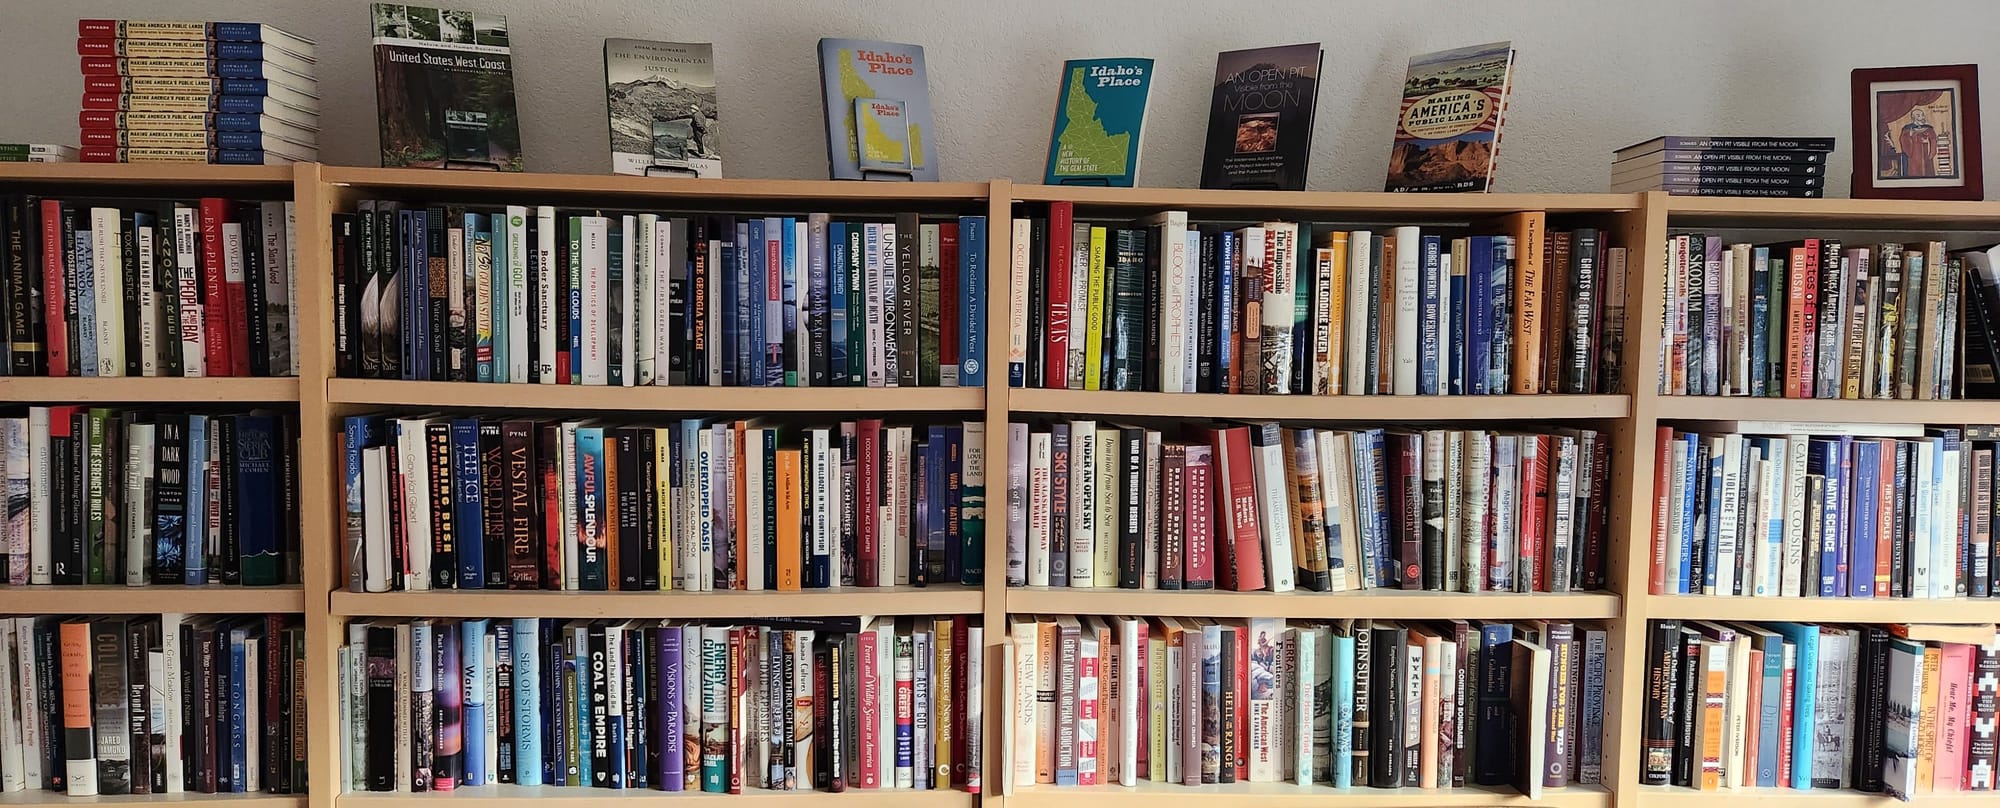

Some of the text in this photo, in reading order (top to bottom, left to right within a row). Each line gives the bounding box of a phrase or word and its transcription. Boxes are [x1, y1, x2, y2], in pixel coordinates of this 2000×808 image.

[389, 50, 506, 71] United States West Coast
[633, 54, 707, 64] ENVIRONMENTAL
[857, 50, 913, 64] Idaho's
[868, 63, 914, 76] Place
[1090, 65, 1144, 77] Idaho's
[1224, 66, 1307, 85] AN OPEN PIT
[1097, 77, 1141, 88] Place
[1223, 89, 1301, 112] MOON
[1427, 93, 1471, 104] MAKING
[871, 103, 899, 111] Idaho's
[1408, 112, 1483, 127] PUBLIC LANDS
[1410, 99, 1485, 119] AMERICA'S
[1059, 164, 1070, 172] THE
[1082, 164, 1098, 172] STATE
[1060, 157, 1081, 165] HISTORY
[204, 217, 215, 242] END
[67, 249, 77, 287] YOSEMITE
[206, 252, 218, 298] PLENTY
[229, 234, 239, 274] BOWLER
[969, 252, 977, 262] To
[1093, 246, 1101, 274] SHAPING
[1263, 229, 1275, 294] RAILWAY
[1274, 230, 1286, 295] The Impossible
[1792, 254, 1804, 299] BULOSAN
[11, 229, 25, 336] THE ANIMAL GAME
[68, 289, 77, 315] MAFIA
[161, 226, 176, 335] TANOAK TREE
[540, 250, 549, 331] Border Sanctuary
[571, 239, 580, 320] TO THE WHITE CLOUDS
[695, 255, 704, 350] THE GEORGIA PEACH
[902, 244, 912, 336] YELLOW RIVER
[969, 264, 977, 294] Reclaim
[1092, 289, 1100, 311] PUBLIC
[1523, 269, 1535, 335] THE FAR WEST
[1688, 254, 1703, 312] SKOOKUM
[1049, 302, 1068, 344] TEXAS
[1317, 261, 1330, 353] THE KLONDIKE FEVER
[90, 417, 102, 521] CARROLL THE SERENGETI RULES
[347, 424, 358, 475] Saving Florida
[464, 442, 479, 504] THE ICE
[438, 435, 452, 553] BURNING BUSH
[511, 447, 529, 555] VESTAL FIRE
[701, 451, 710, 552] OVERTAPPED OASIS
[1053, 451, 1067, 514] SKI STYLE
[1083, 435, 1092, 531] UNDER AN OPEN SKY
[1790, 443, 1806, 565] CAPTIVES COUSINS
[1824, 478, 1837, 553] NATIVE SCIENCE
[702, 638, 714, 713] CIVILIZATION
[714, 643, 727, 686] ENERGY
[864, 644, 874, 664] Forest
[864, 665, 874, 678] and
[1275, 641, 1284, 689] Frontiers
[1355, 628, 1369, 712] JOHN SUTTER
[1411, 656, 1421, 698] WYATT
[437, 667, 445, 691] Nation
[464, 665, 475, 703] Water
[520, 652, 531, 750] SEA OF STORMS
[666, 663, 677, 699] VISIONS
[759, 659, 770, 743] TOXIC EXPOSURES
[784, 654, 793, 747] ROAD THROUGH TIME
[864, 679, 876, 707] Wildlife
[1591, 636, 1605, 727] THE PACIFIC PROVINCE
[1660, 649, 1671, 720] AMERICAN INDIAN
[130, 684, 145, 735] Beyond Rust
[232, 681, 241, 748] TONGASS
[593, 651, 606, 758] COAL & EMPIRE
[863, 707, 874, 733] Science
[916, 677, 927, 729] ACTS OF GOD
[1059, 639, 1075, 767] GREAT ARIZONA ORPHAN ABDUCTION
[1945, 682, 1958, 754] Hear Me, My Chiefs!
[667, 711, 678, 754] PARADISE
[1224, 691, 1233, 768] HELL RANGE
[866, 741, 874, 768] America
